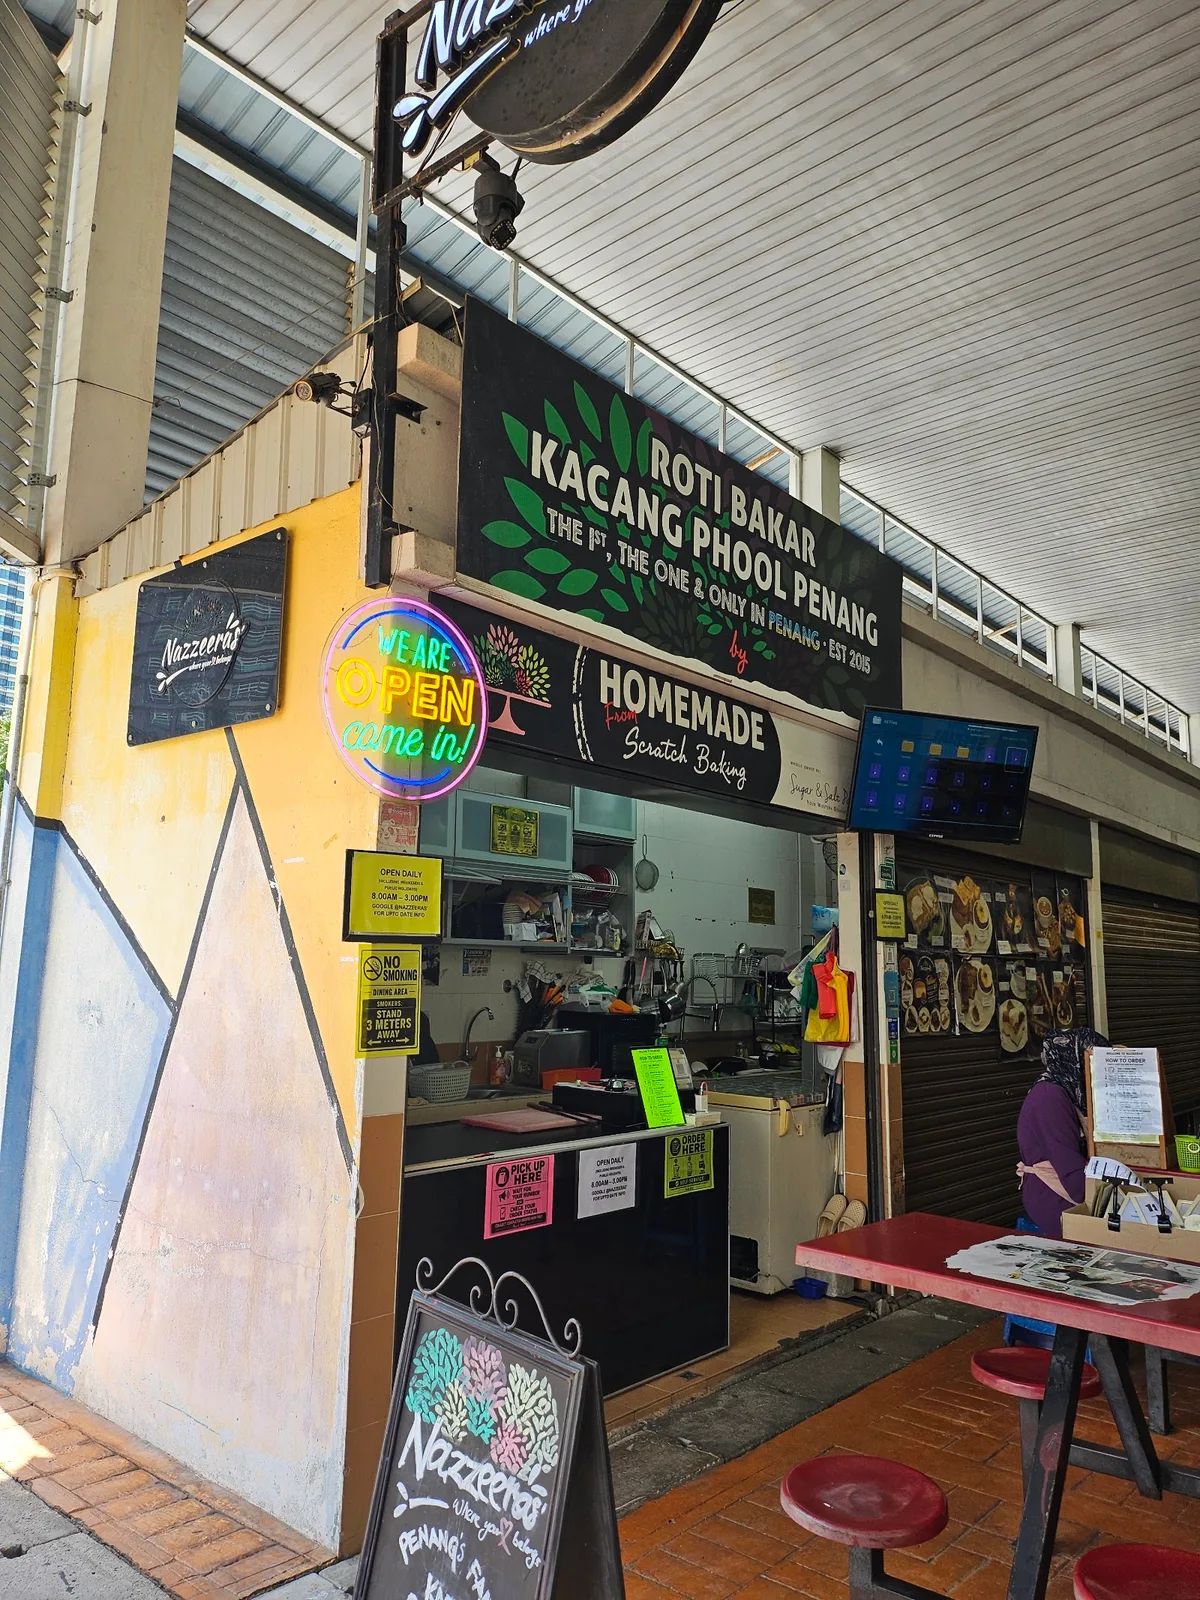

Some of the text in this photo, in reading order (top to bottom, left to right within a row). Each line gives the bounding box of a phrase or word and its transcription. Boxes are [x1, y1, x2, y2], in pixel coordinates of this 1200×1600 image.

[524, 5, 571, 48] where
[651, 437, 816, 568] ROTI BAKAR
[531, 430, 878, 646] KACANG PHOOL PENANG
[546, 507, 583, 546] THE
[618, 540, 649, 576] THE
[654, 559, 689, 594] ONE
[693, 577, 704, 600] &
[709, 584, 747, 618] ONLY
[750, 602, 765, 627] IN
[768, 610, 820, 651] PENANG
[829, 638, 847, 664] EST
[849, 650, 871, 675] 2015
[378, 625, 452, 673] WE ARE
[729, 630, 748, 674] by
[336, 657, 475, 727] OPEN
[600, 659, 764, 751] HOMEMADE
[604, 701, 638, 731] From
[343, 720, 475, 763] come in!
[623, 726, 747, 791] Scratch Baking
[790, 773, 814, 801] Sugar
[815, 782, 822, 798] &
[380, 868, 423, 879] OPEN DAILY
[371, 892, 398, 901] 8.00AM
[404, 893, 429, 903] 3.00PM
[383, 956, 401, 969] NO
[383, 969, 417, 982] SMOKING
[373, 988, 408, 996] DINING AREA
[376, 1009, 402, 1019] STAND
[366, 1017, 412, 1031] 3 METERS
[376, 1030, 400, 1040] AWAY
[682, 1133, 706, 1145] ORDER
[682, 1142, 706, 1155] HERE
[511, 1160, 545, 1175] PICK UP
[596, 1156, 624, 1167] OPEN DAILY
[513, 1171, 542, 1185] HERE
[591, 1179, 609, 1188] 8.00AM
[509, 1205, 524, 1213] CHECK
[523, 1208, 538, 1216] STATUS
